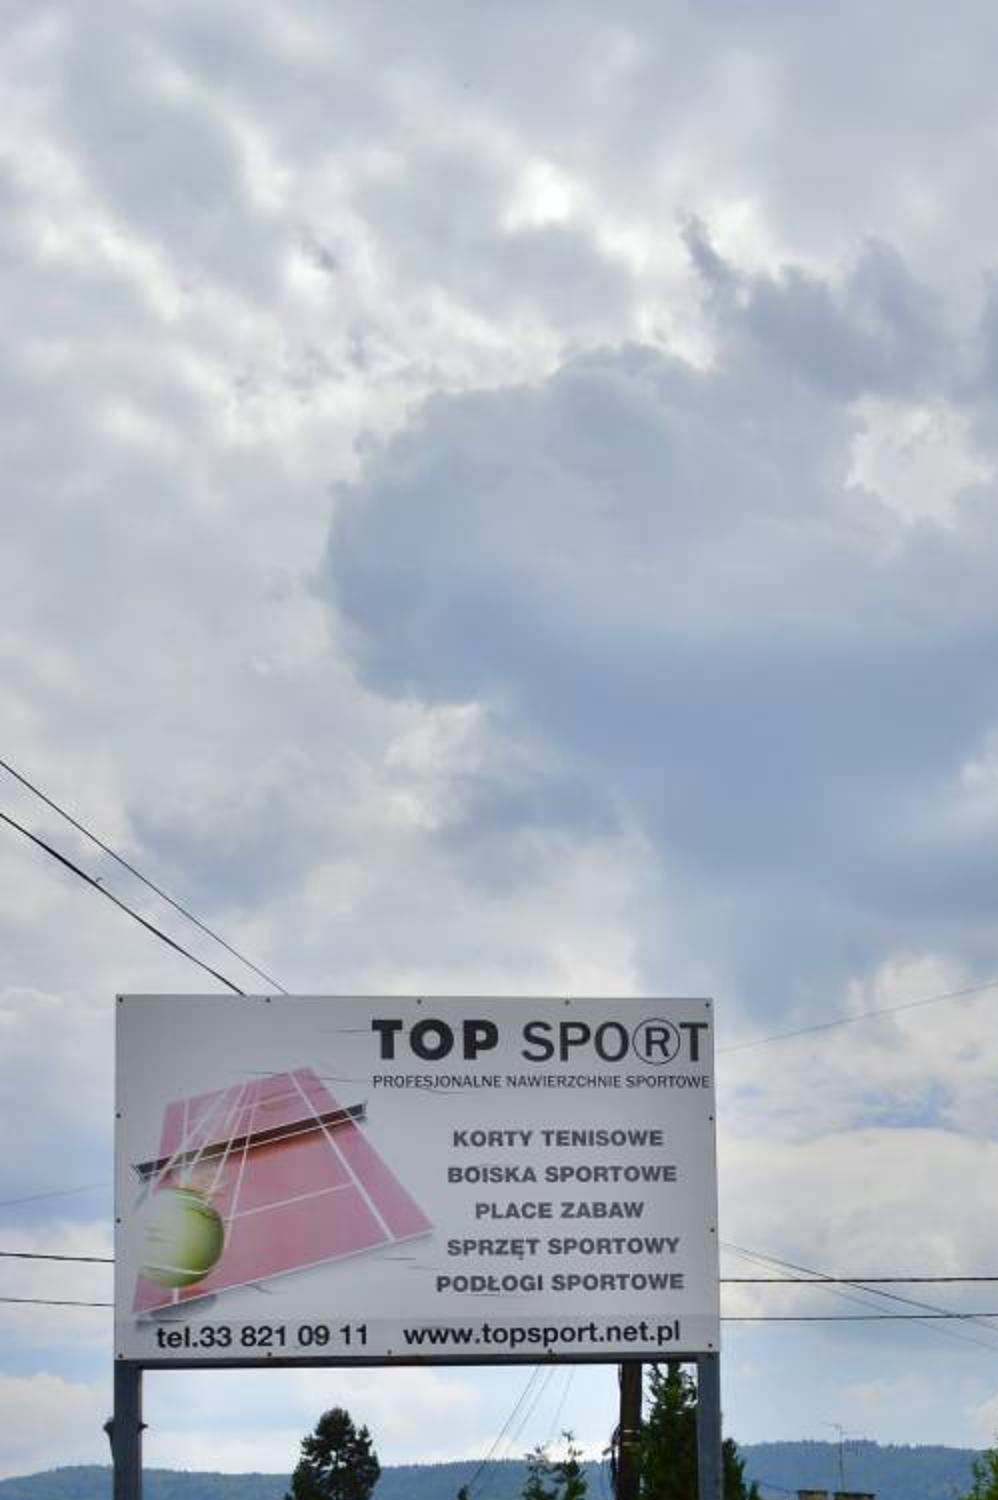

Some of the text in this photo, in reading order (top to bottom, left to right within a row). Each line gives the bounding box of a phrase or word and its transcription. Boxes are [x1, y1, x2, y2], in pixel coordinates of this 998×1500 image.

[371, 1018, 499, 1061] TOP
[372, 1074, 711, 1090] PROFESJONALNE NAWIERZCHNIE SPORTOWE
[452, 1129, 665, 1148] KORTY TENISOWE
[447, 1164, 678, 1184] BOISKA SPORTOWE
[475, 1201, 645, 1220] PLACE ZABAW
[447, 1237, 681, 1260] SPRZĘT SPORTOWY
[436, 1273, 686, 1293] PODŁOGI SPORTOWE
[156, 1323, 369, 1349] tel.33 821 09 11
[403, 1319, 681, 1349] www.topsport.net.pl
